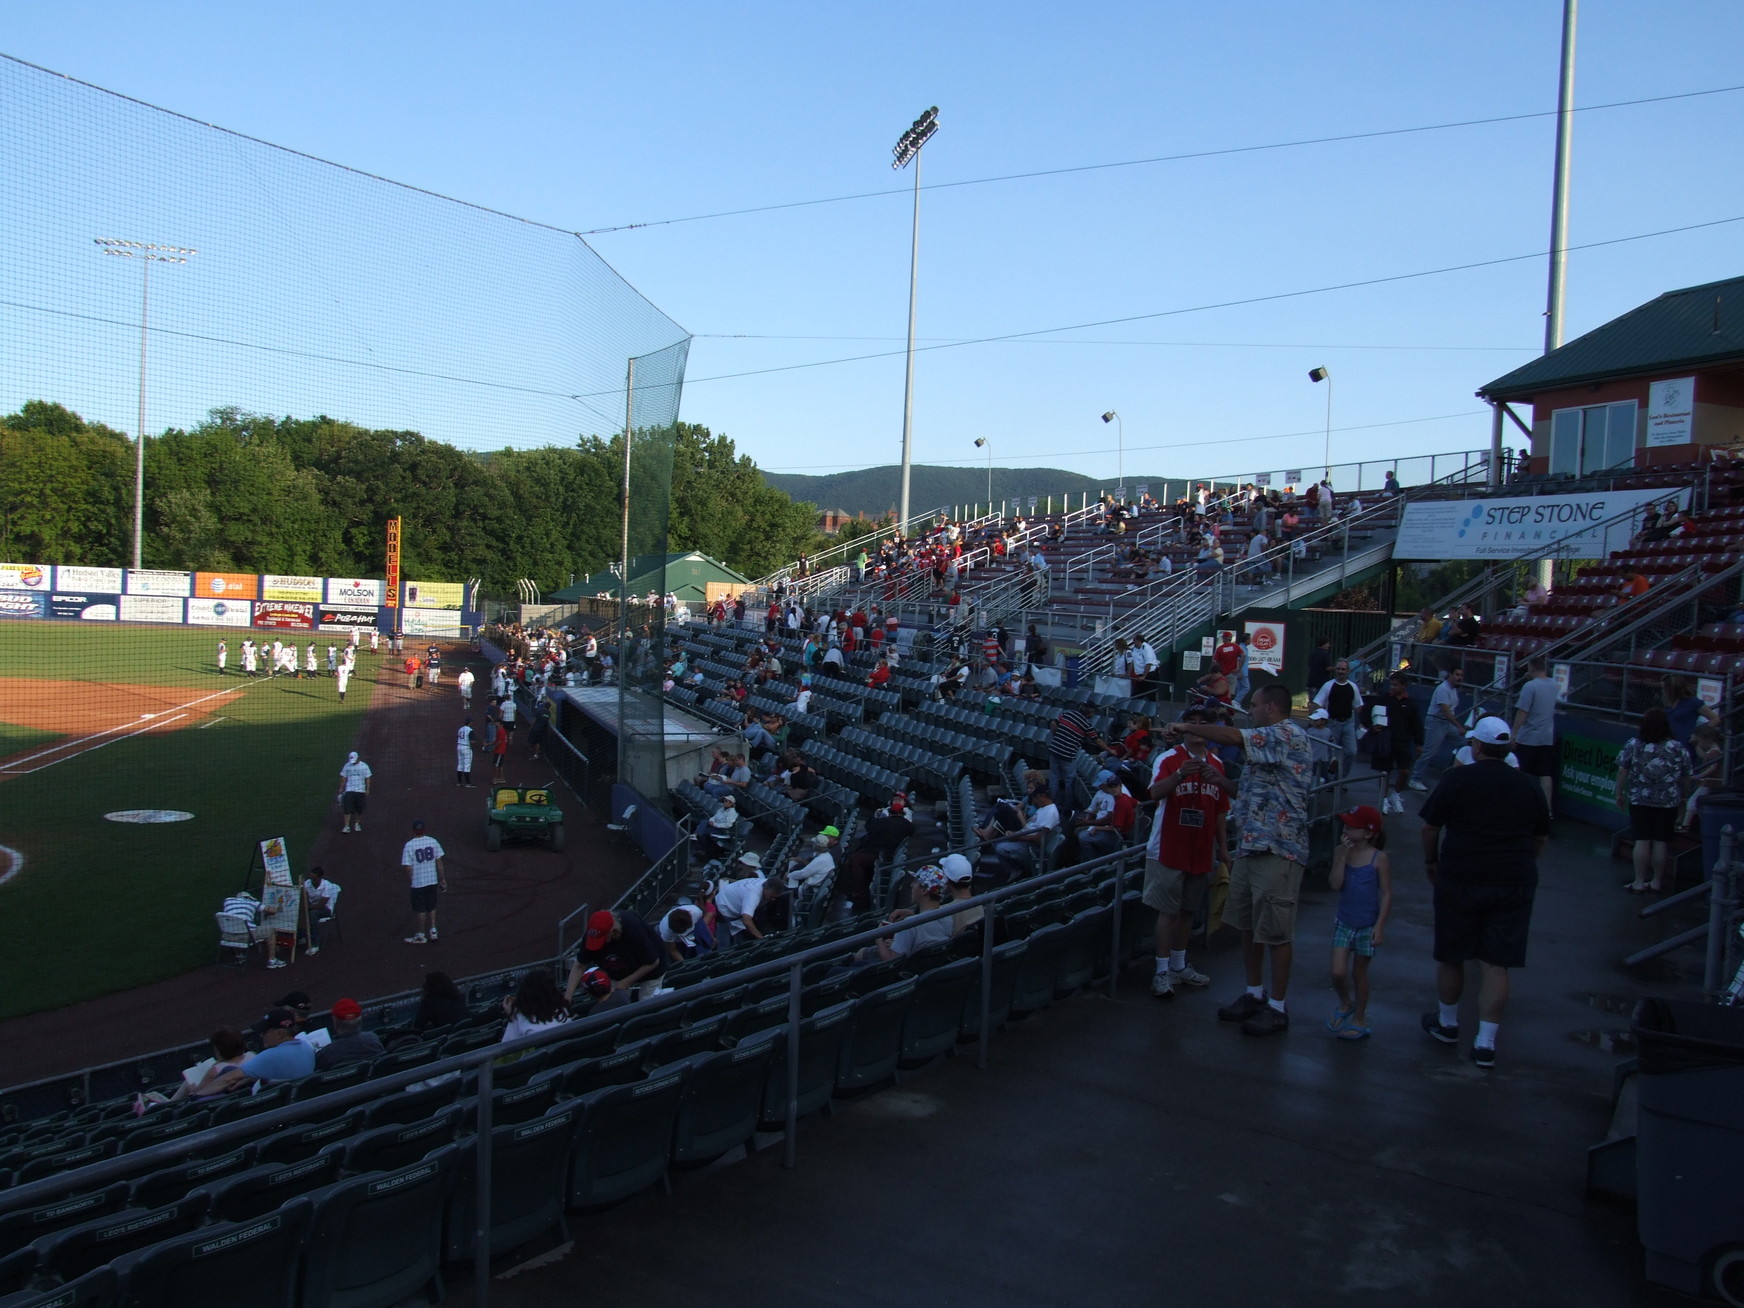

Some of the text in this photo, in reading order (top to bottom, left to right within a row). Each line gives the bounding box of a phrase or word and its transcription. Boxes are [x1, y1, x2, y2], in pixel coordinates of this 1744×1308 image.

[1485, 501, 1606, 525] STEP STONE
[339, 588, 375, 597] MOLSON
[1564, 740, 1592, 766] Direct
[414, 846, 435, 864] 08
[520, 1115, 568, 1137] WALDEN FEDERAL
[376, 1167, 431, 1191] WALDEN FEDERAL
[103, 1212, 170, 1238] LEO'S RISTORANTE
[202, 1222, 273, 1252] WALDEN FEDERAL
